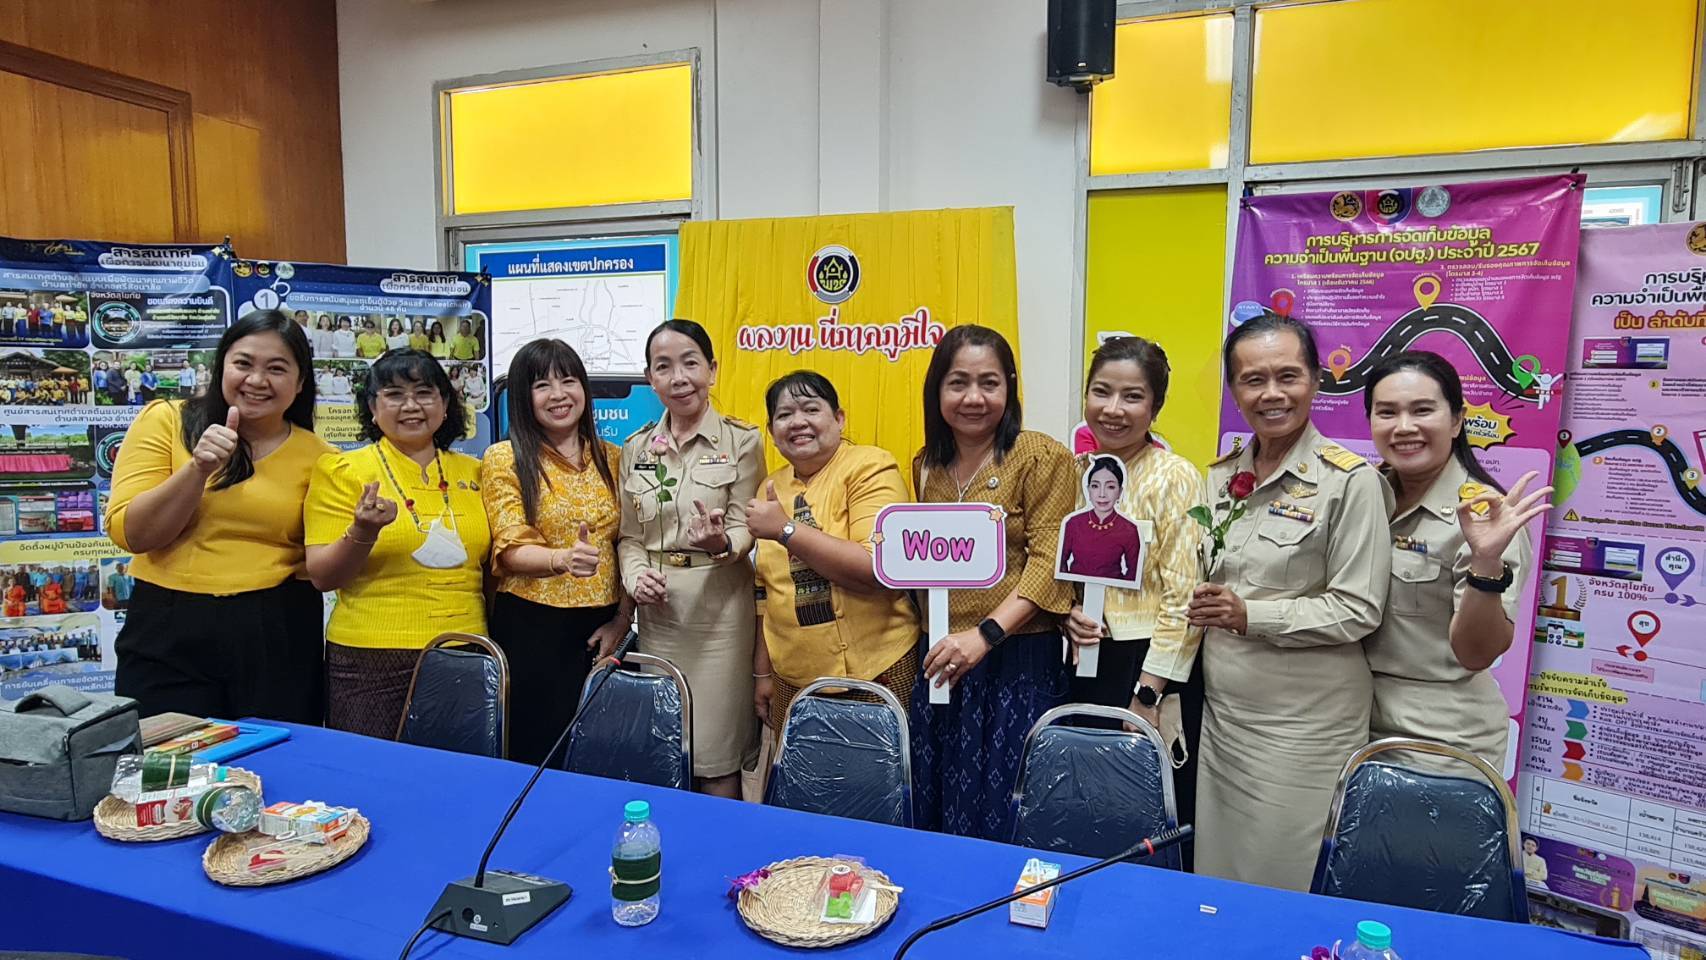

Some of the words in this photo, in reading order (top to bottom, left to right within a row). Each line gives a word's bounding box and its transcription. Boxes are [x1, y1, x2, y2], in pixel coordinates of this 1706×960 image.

[1306, 226, 1490, 247] การบริหารการจัดเก็บข้อมูล
[111, 247, 192, 258] สารสนเทศ
[1264, 245, 1387, 265] ความจำเป็นพื้นฐาน
[1389, 247, 1435, 264] (จปฐ.)
[1497, 243, 1540, 257] 2567
[100, 257, 205, 270] เพื่อการพัฒนาชุมชน
[508, 254, 634, 275] แผนที่แสดงเขตปกครอง
[392, 274, 459, 284] สารสนเทศ
[382, 282, 469, 294] เพื่อการพัฒนาชุมชน
[1614, 312, 1643, 328] เป็น
[739, 326, 813, 352] ผลงาน
[818, 308, 944, 359] ที่ภาคภูมิใจ
[902, 528, 976, 562] Wow
[1588, 578, 1655, 593] จังหวัดสุโขทัย
[1593, 589, 1614, 598] ครบ
[1617, 589, 1648, 601] 100%
